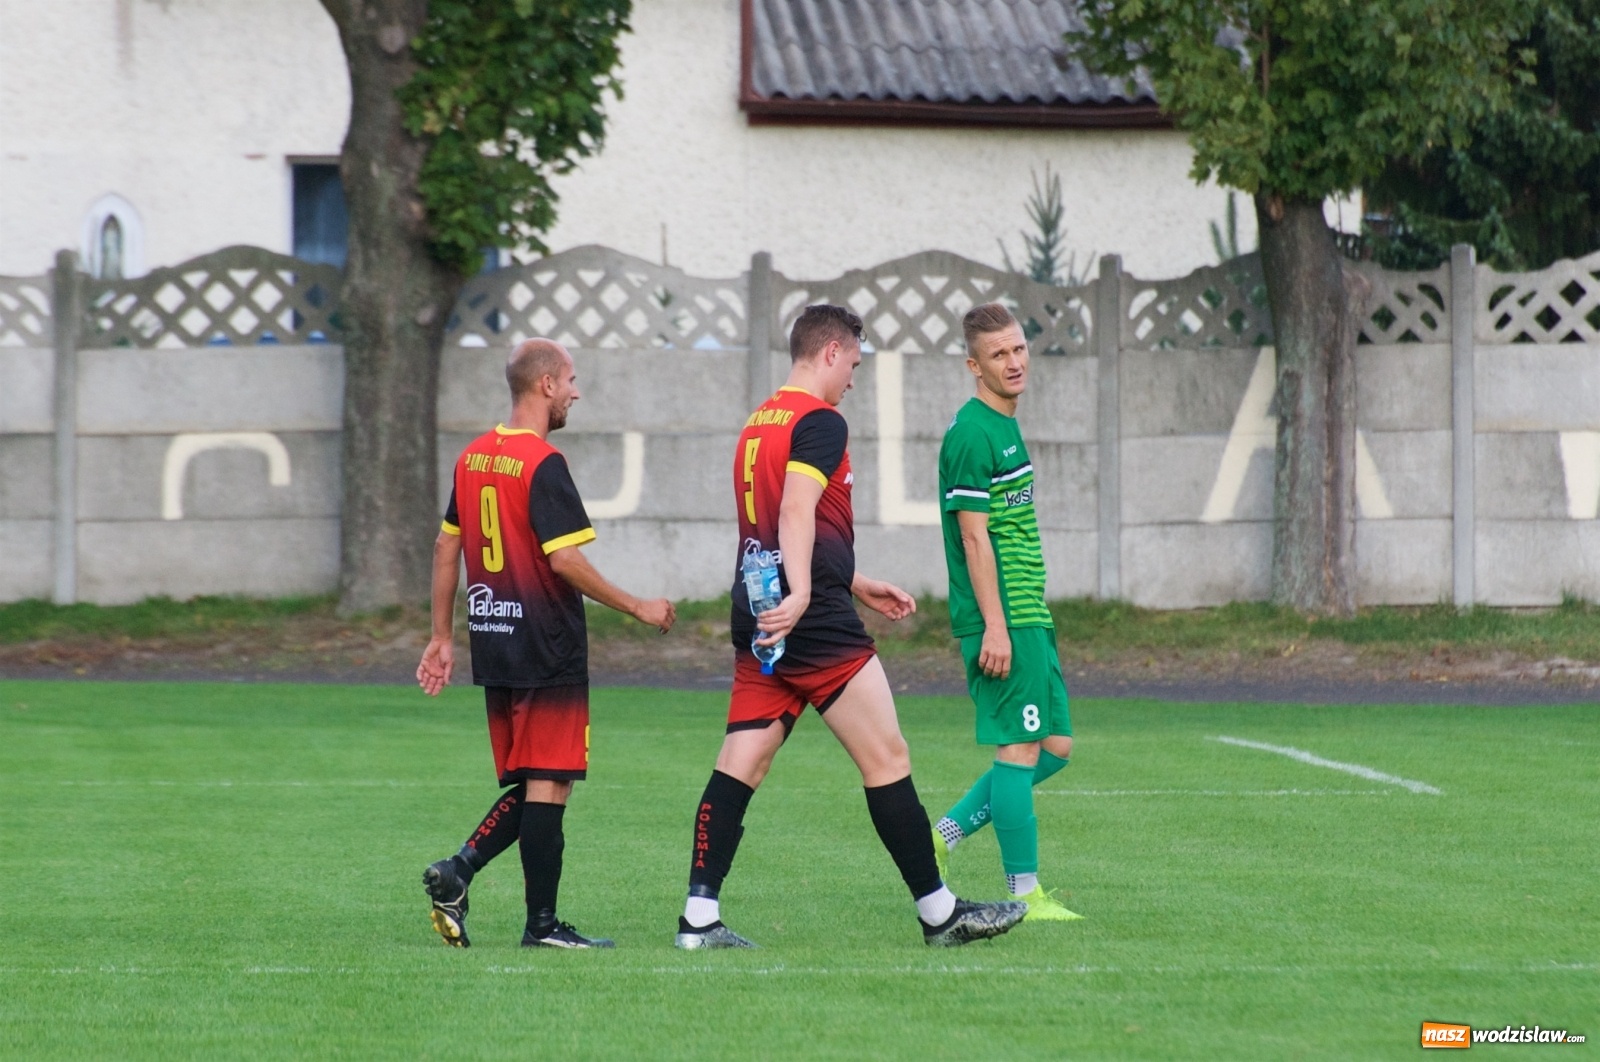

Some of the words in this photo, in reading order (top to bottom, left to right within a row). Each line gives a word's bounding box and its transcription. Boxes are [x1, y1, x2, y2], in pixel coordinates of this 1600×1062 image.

[743, 436, 762, 525] 5
[480, 484, 504, 574] 9
[1022, 704, 1041, 732] 8
